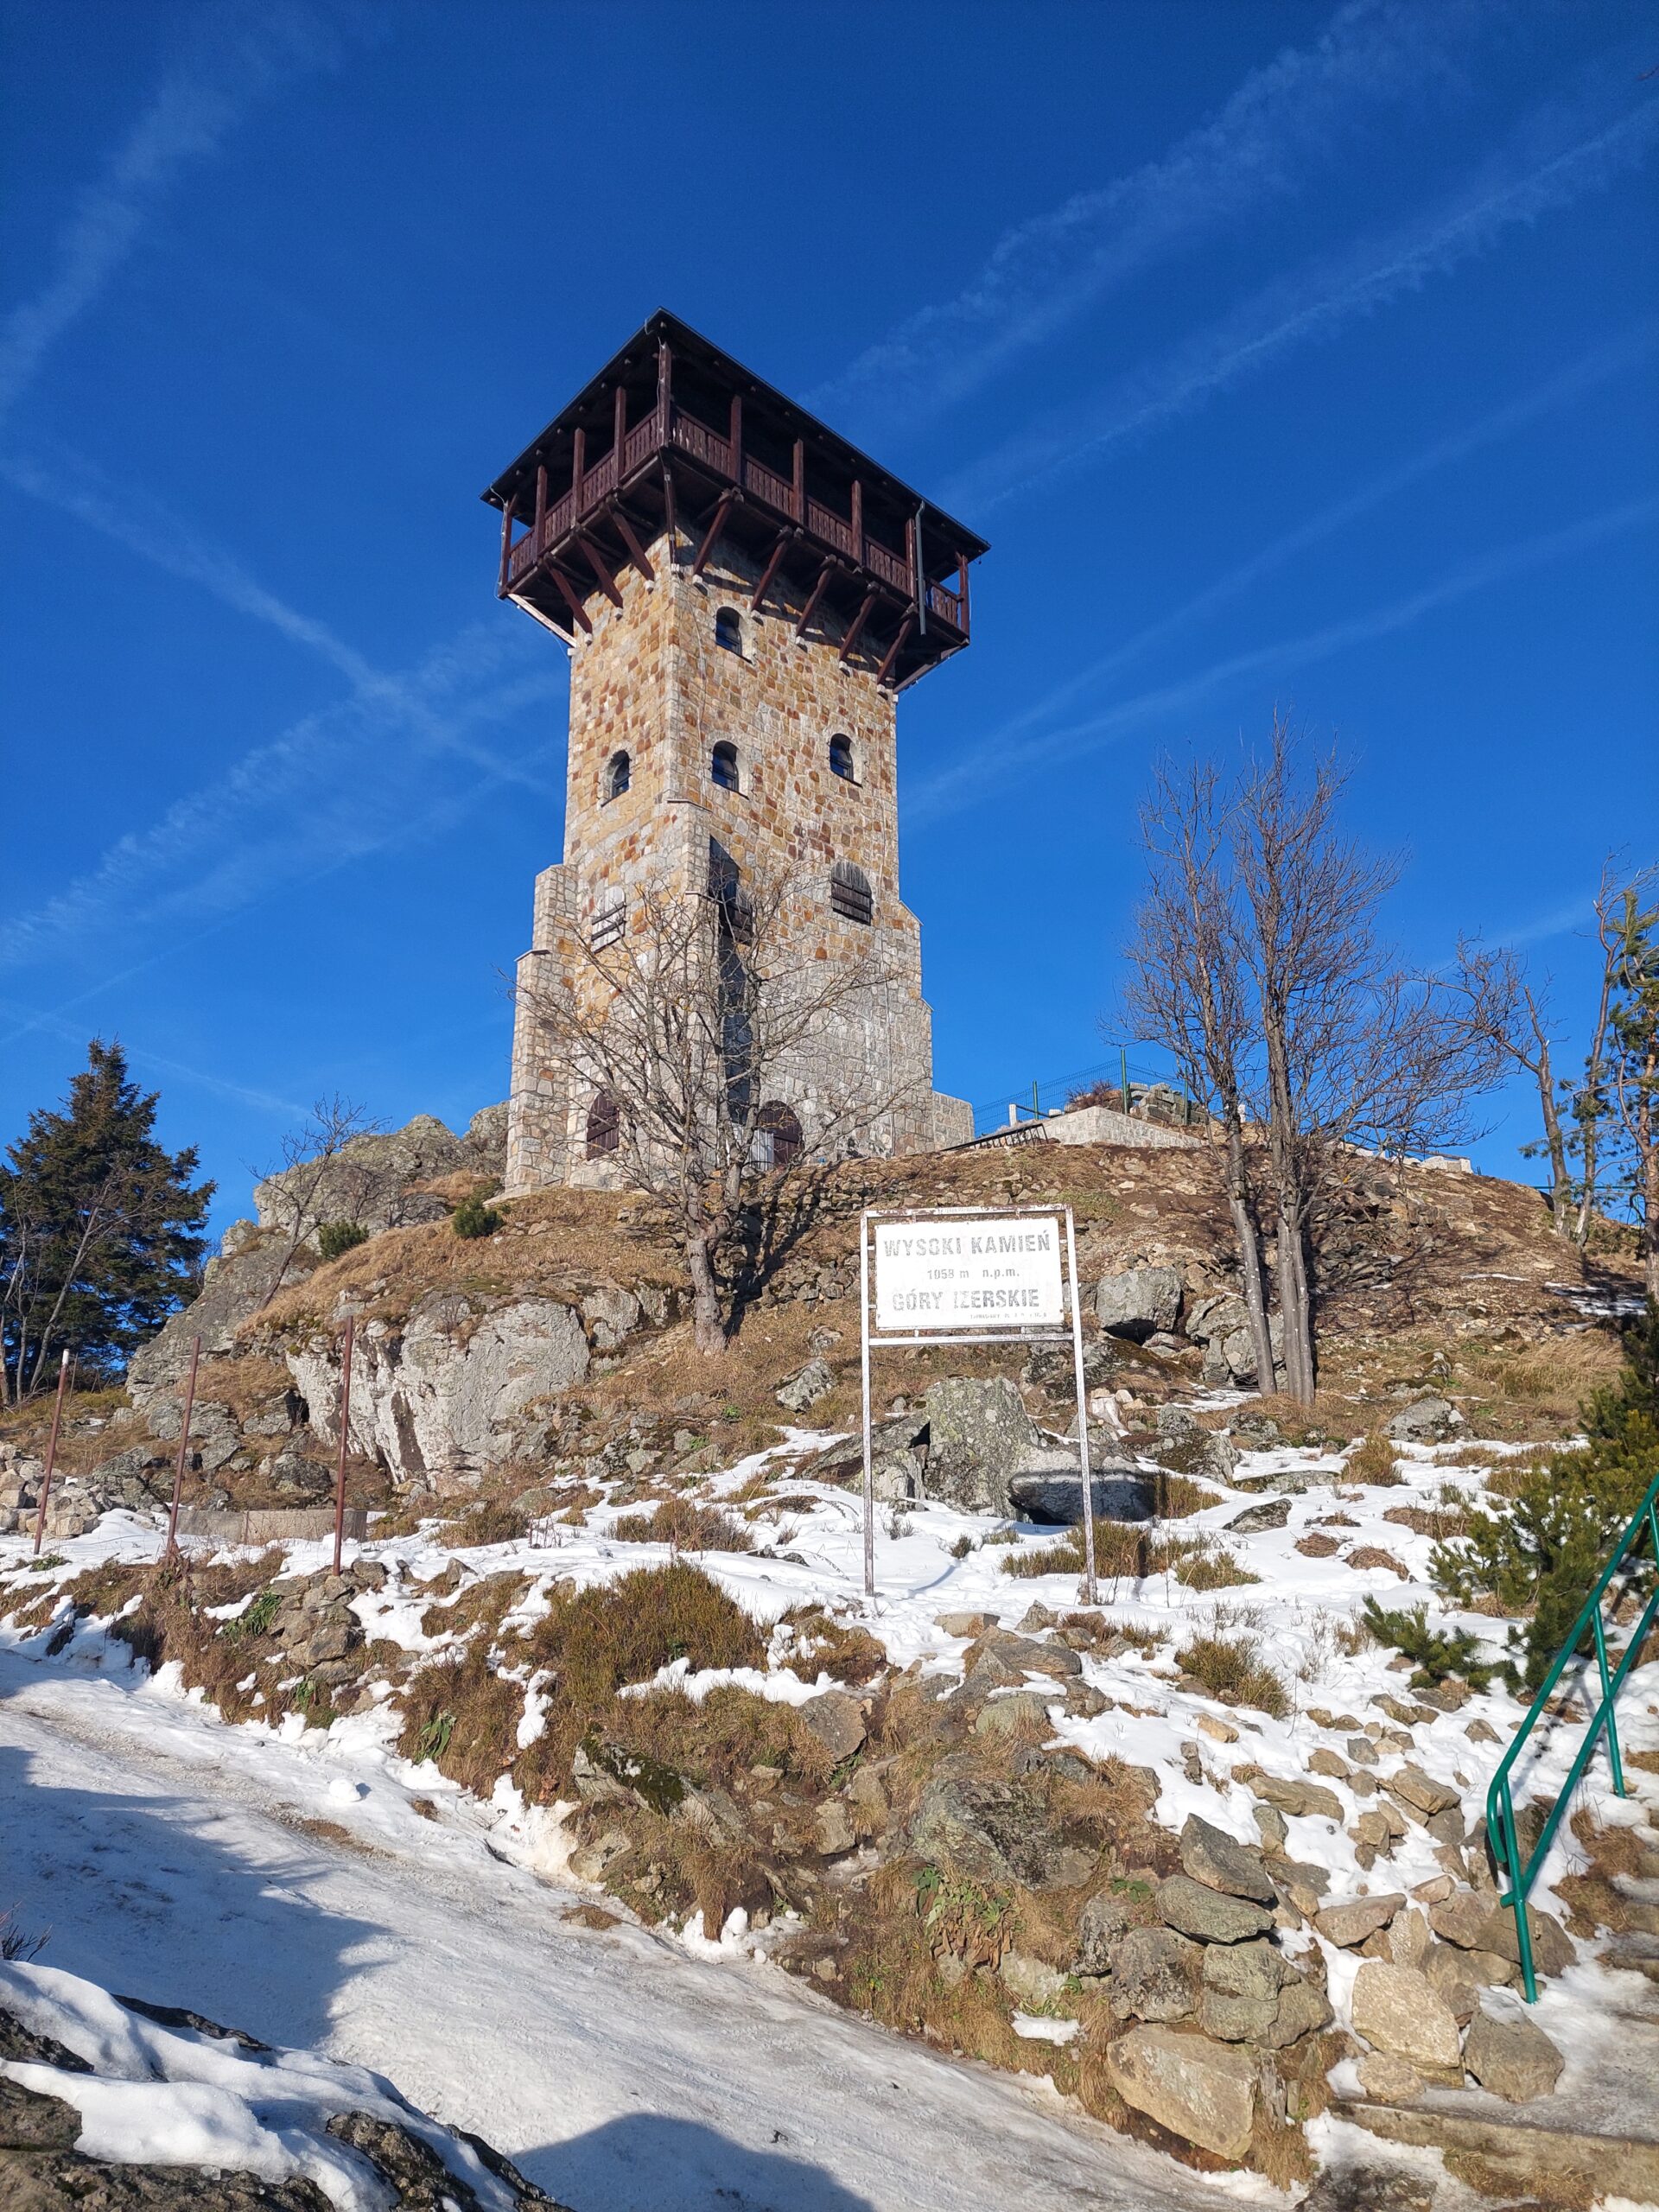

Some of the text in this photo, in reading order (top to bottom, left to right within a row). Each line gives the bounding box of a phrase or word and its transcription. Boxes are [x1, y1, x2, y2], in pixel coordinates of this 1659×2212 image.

[884, 1230, 1050, 1256] WYSOKI KAMIEŃ
[927, 1268, 1020, 1279] 1058 m n.p.m.
[893, 1288, 1039, 1311] GÓRY IZERSKIE
